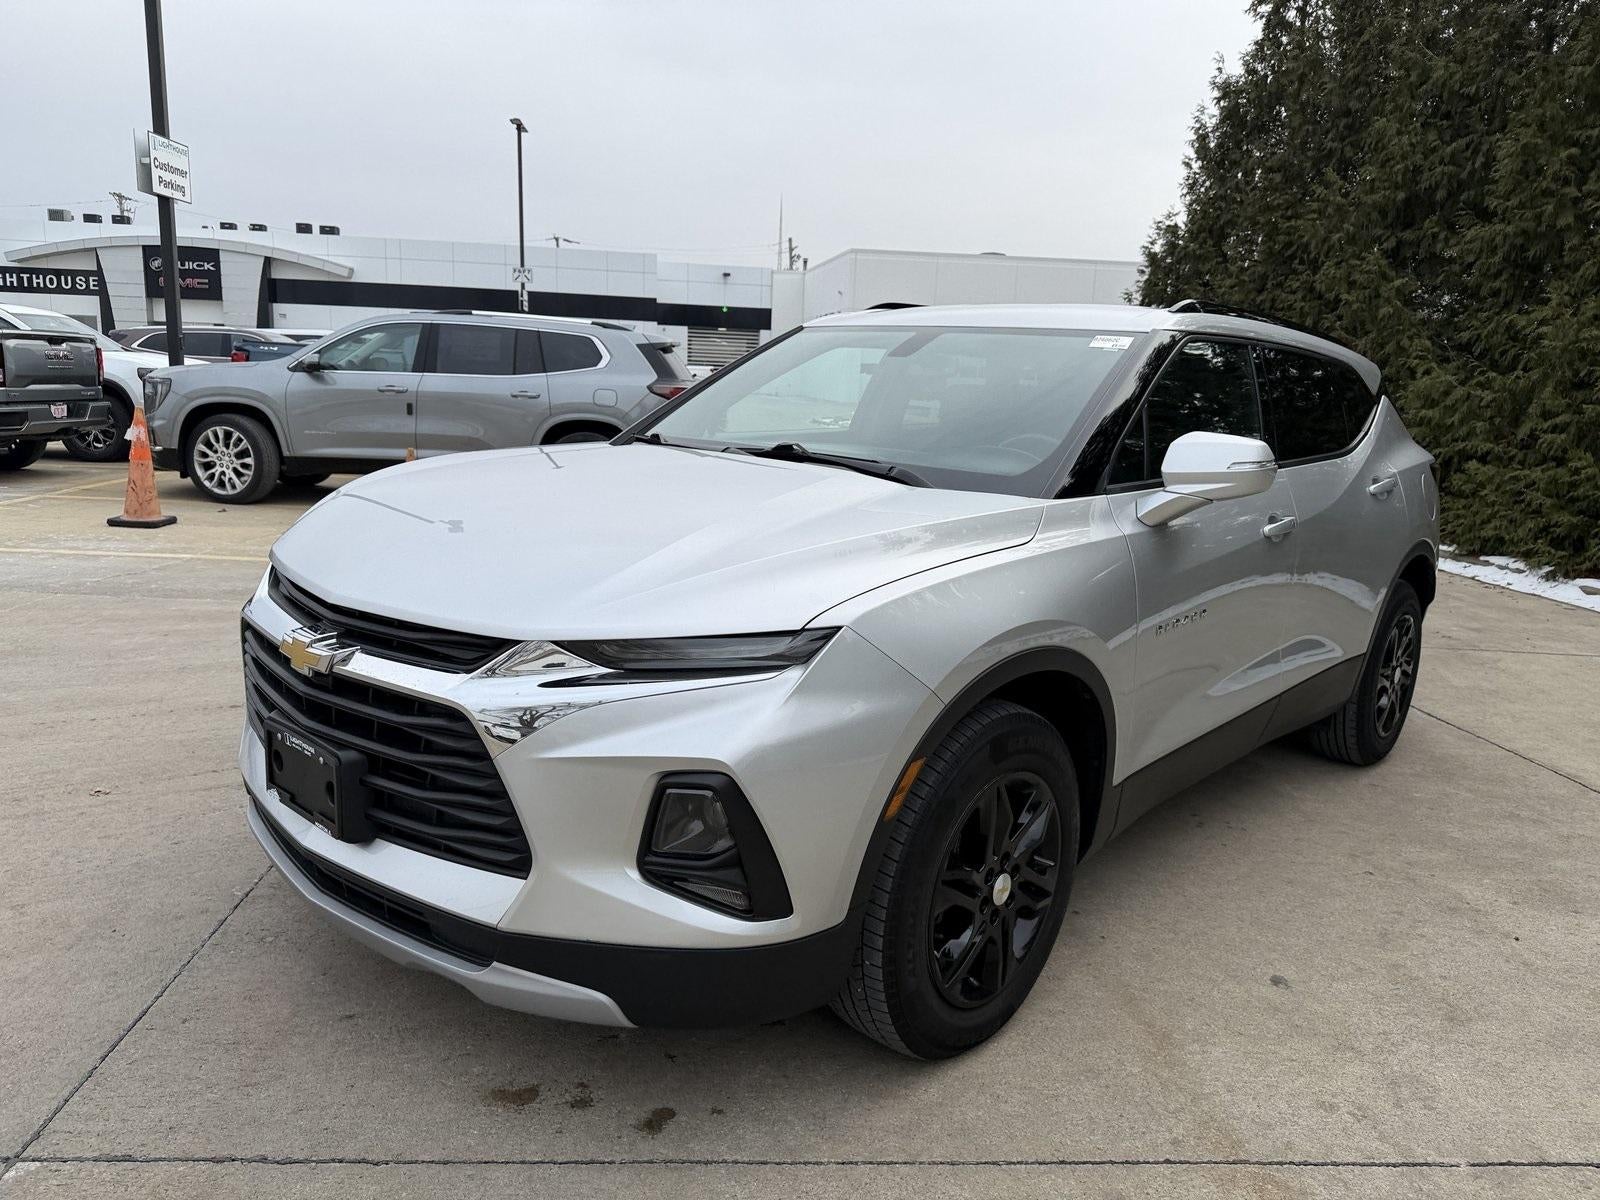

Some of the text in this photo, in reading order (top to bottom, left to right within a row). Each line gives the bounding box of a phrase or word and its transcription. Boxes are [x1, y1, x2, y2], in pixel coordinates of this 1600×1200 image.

[153, 156, 188, 179] Customer
[158, 175, 186, 197] Parking
[178, 260, 217, 271] UICK
